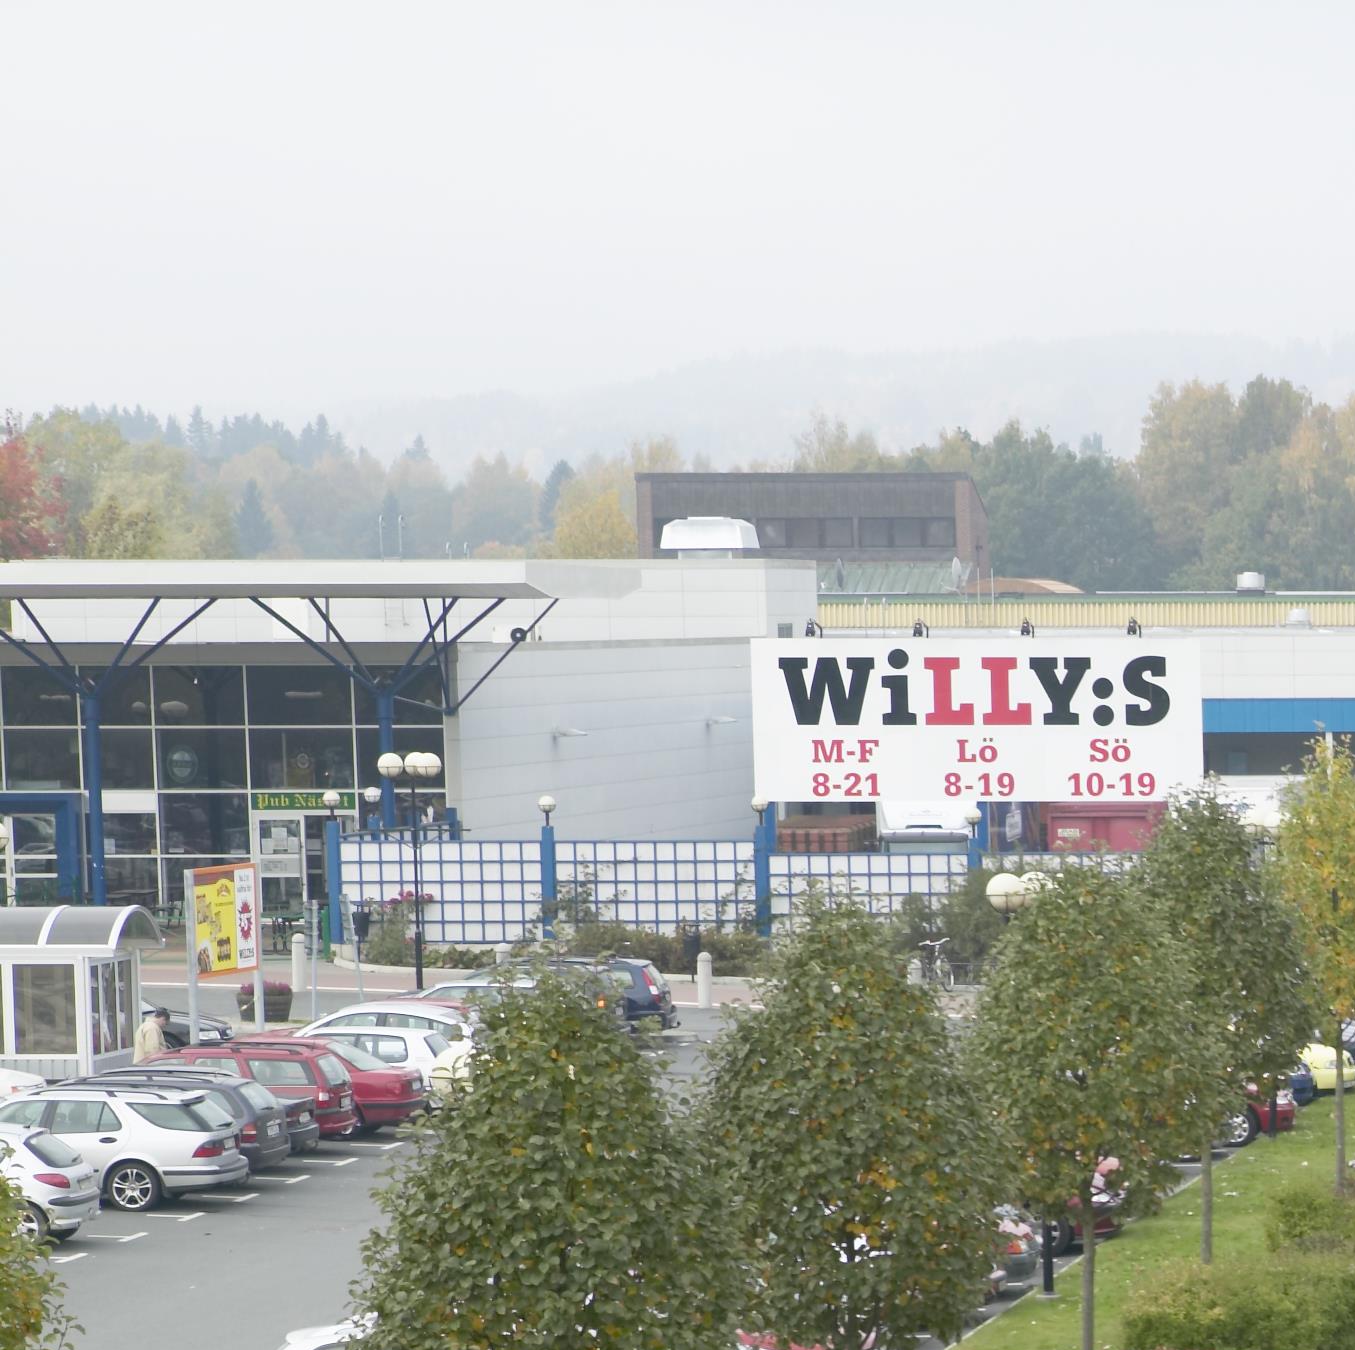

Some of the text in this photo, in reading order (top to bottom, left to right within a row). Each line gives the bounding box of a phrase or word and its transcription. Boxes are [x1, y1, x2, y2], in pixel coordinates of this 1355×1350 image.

[778, 648, 1171, 727] WiLLY:S
[812, 739, 880, 763] M-F
[956, 737, 998, 763] Lö
[1089, 738, 1131, 763] Sö
[812, 772, 881, 797] 8-21
[944, 772, 1015, 797] 8-19
[1067, 772, 1156, 797] 10-19
[257, 794, 289, 809] Pub
